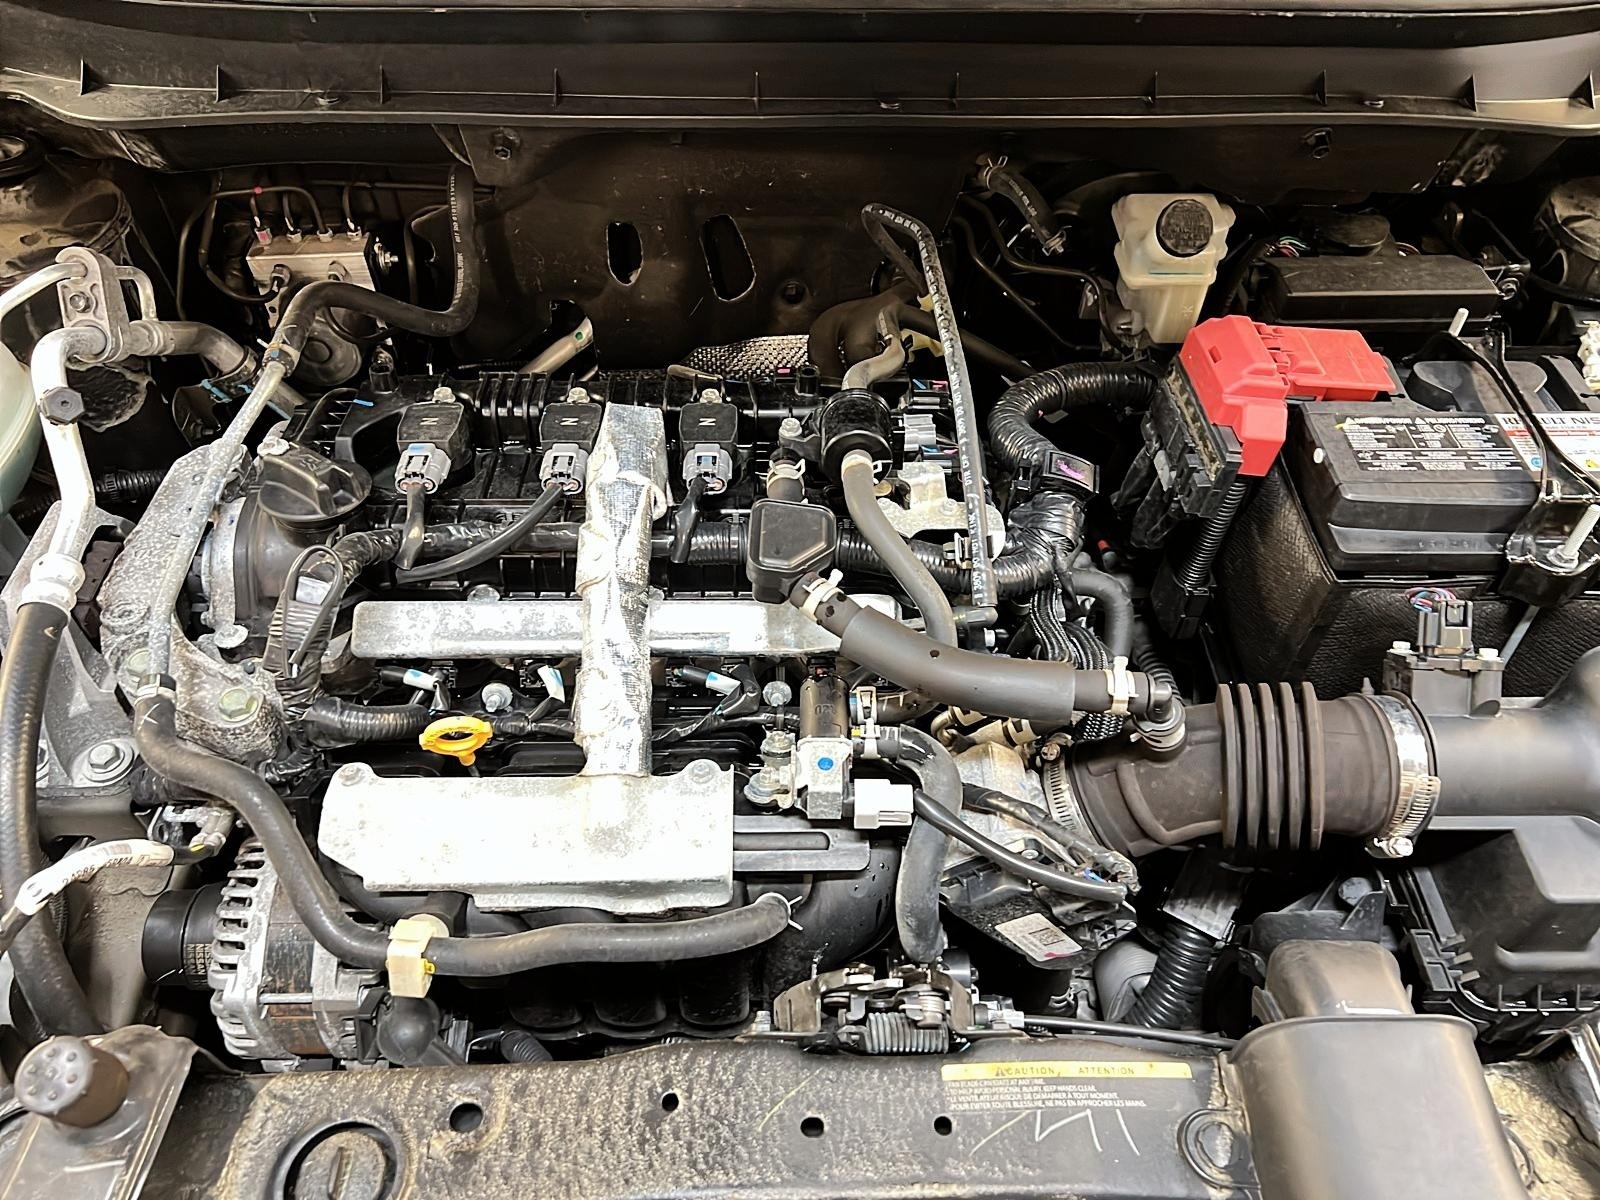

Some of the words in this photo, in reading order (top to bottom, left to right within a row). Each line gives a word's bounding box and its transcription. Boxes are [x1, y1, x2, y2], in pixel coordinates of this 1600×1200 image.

[195, 943, 207, 975] NISSAN
[1006, 1067, 1056, 1076] CAUTION
[1078, 1066, 1135, 1075] ATTENTION
